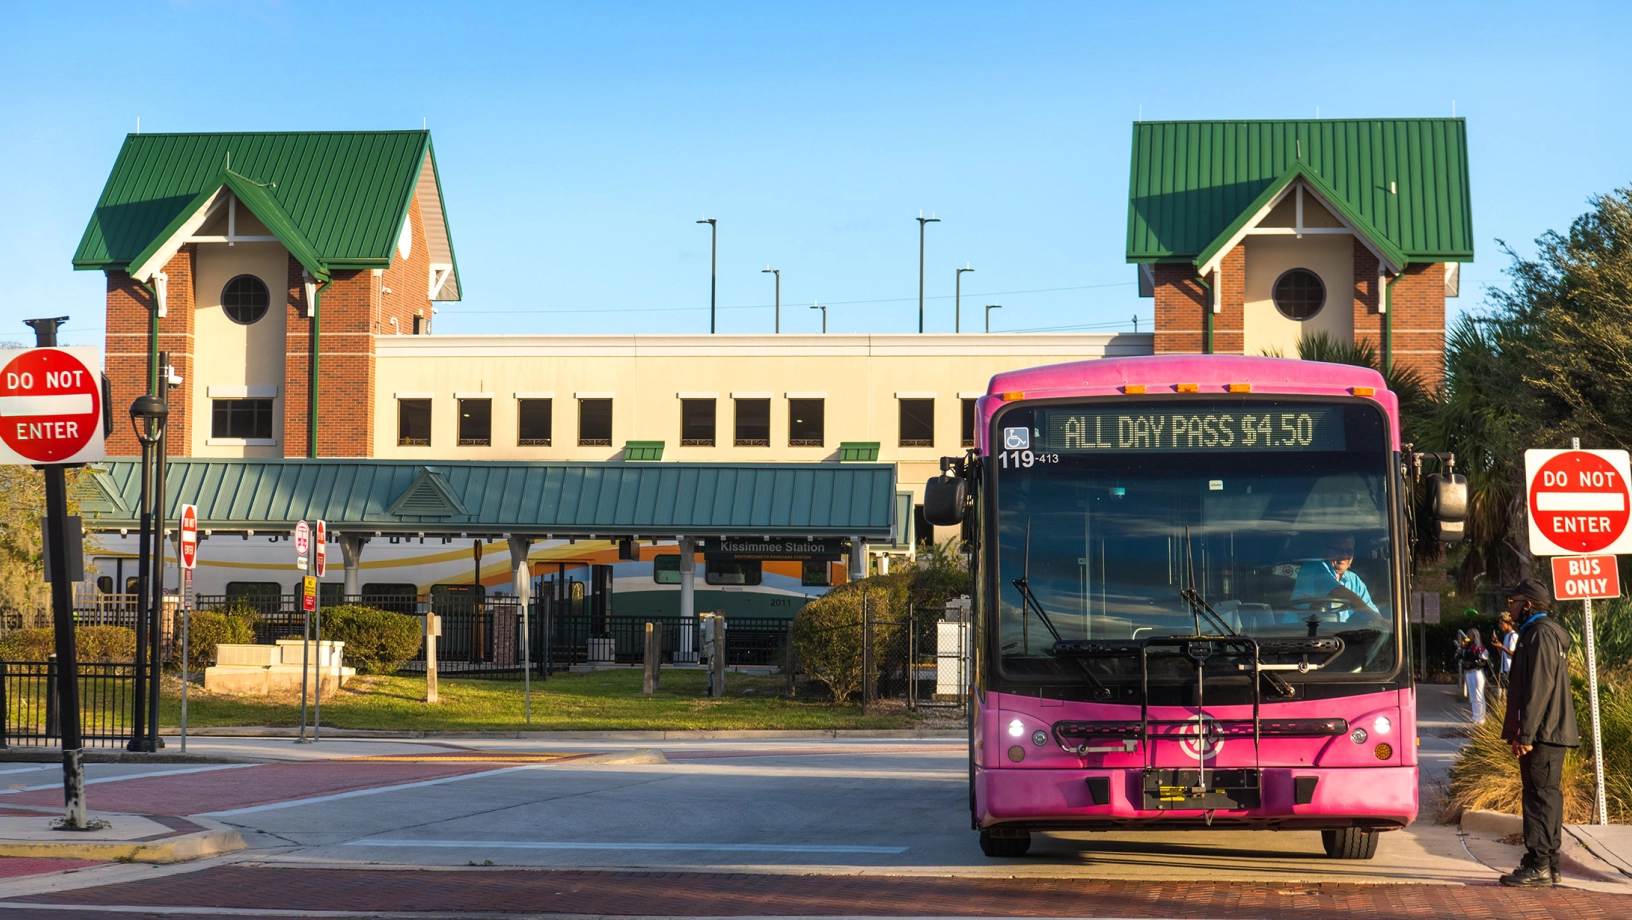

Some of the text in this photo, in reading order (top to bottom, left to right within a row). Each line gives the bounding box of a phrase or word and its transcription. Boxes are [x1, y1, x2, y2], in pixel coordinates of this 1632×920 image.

[7, 370, 83, 390] DO NOT
[16, 421, 79, 440] ENTER
[1065, 413, 1313, 449] ALL DAY PASS $4.50
[1543, 471, 1616, 488] DO NOT
[1552, 516, 1611, 533] ENTER
[720, 541, 825, 552] Kissimmee Station
[1568, 559, 1601, 576] BUS
[1565, 578, 1608, 596] ONLY
[770, 598, 791, 607] 2011
